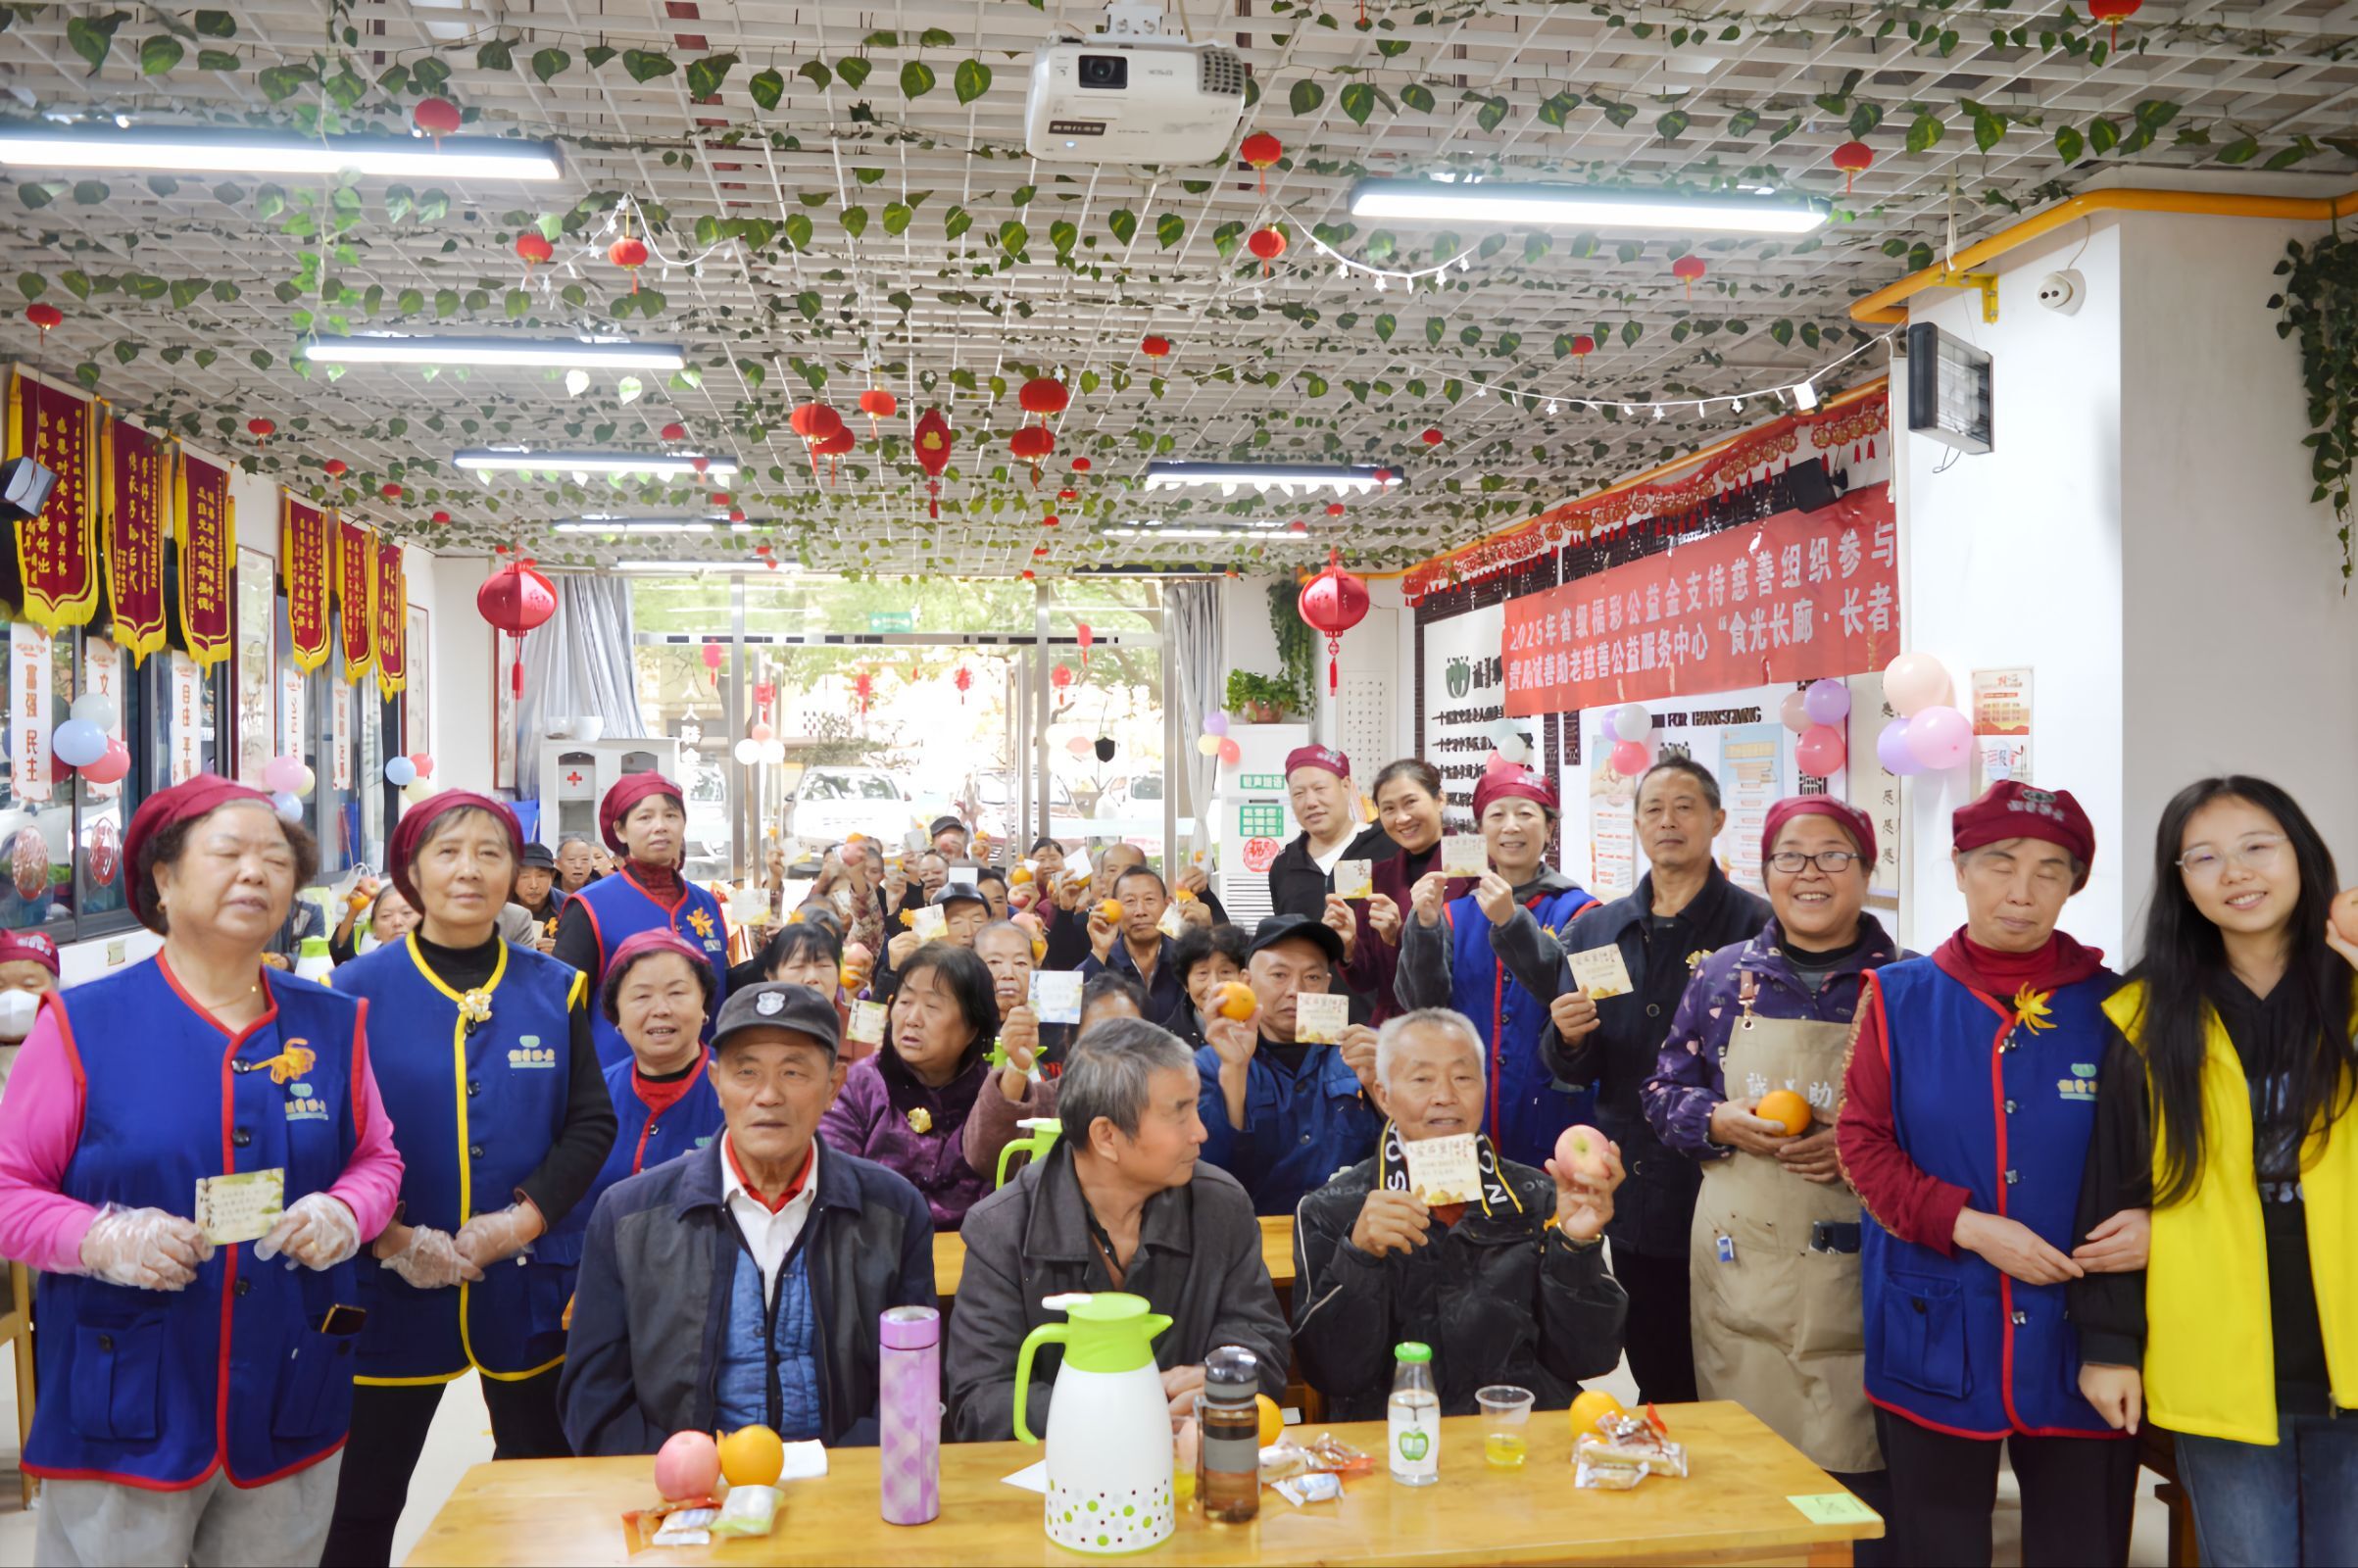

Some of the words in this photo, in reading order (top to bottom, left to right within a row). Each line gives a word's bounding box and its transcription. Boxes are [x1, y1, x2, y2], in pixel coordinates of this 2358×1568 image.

[1718, 581, 1900, 657] “食光长廊·长者
[1668, 712, 1688, 727] FOR
[25, 729, 38, 782] 民主
